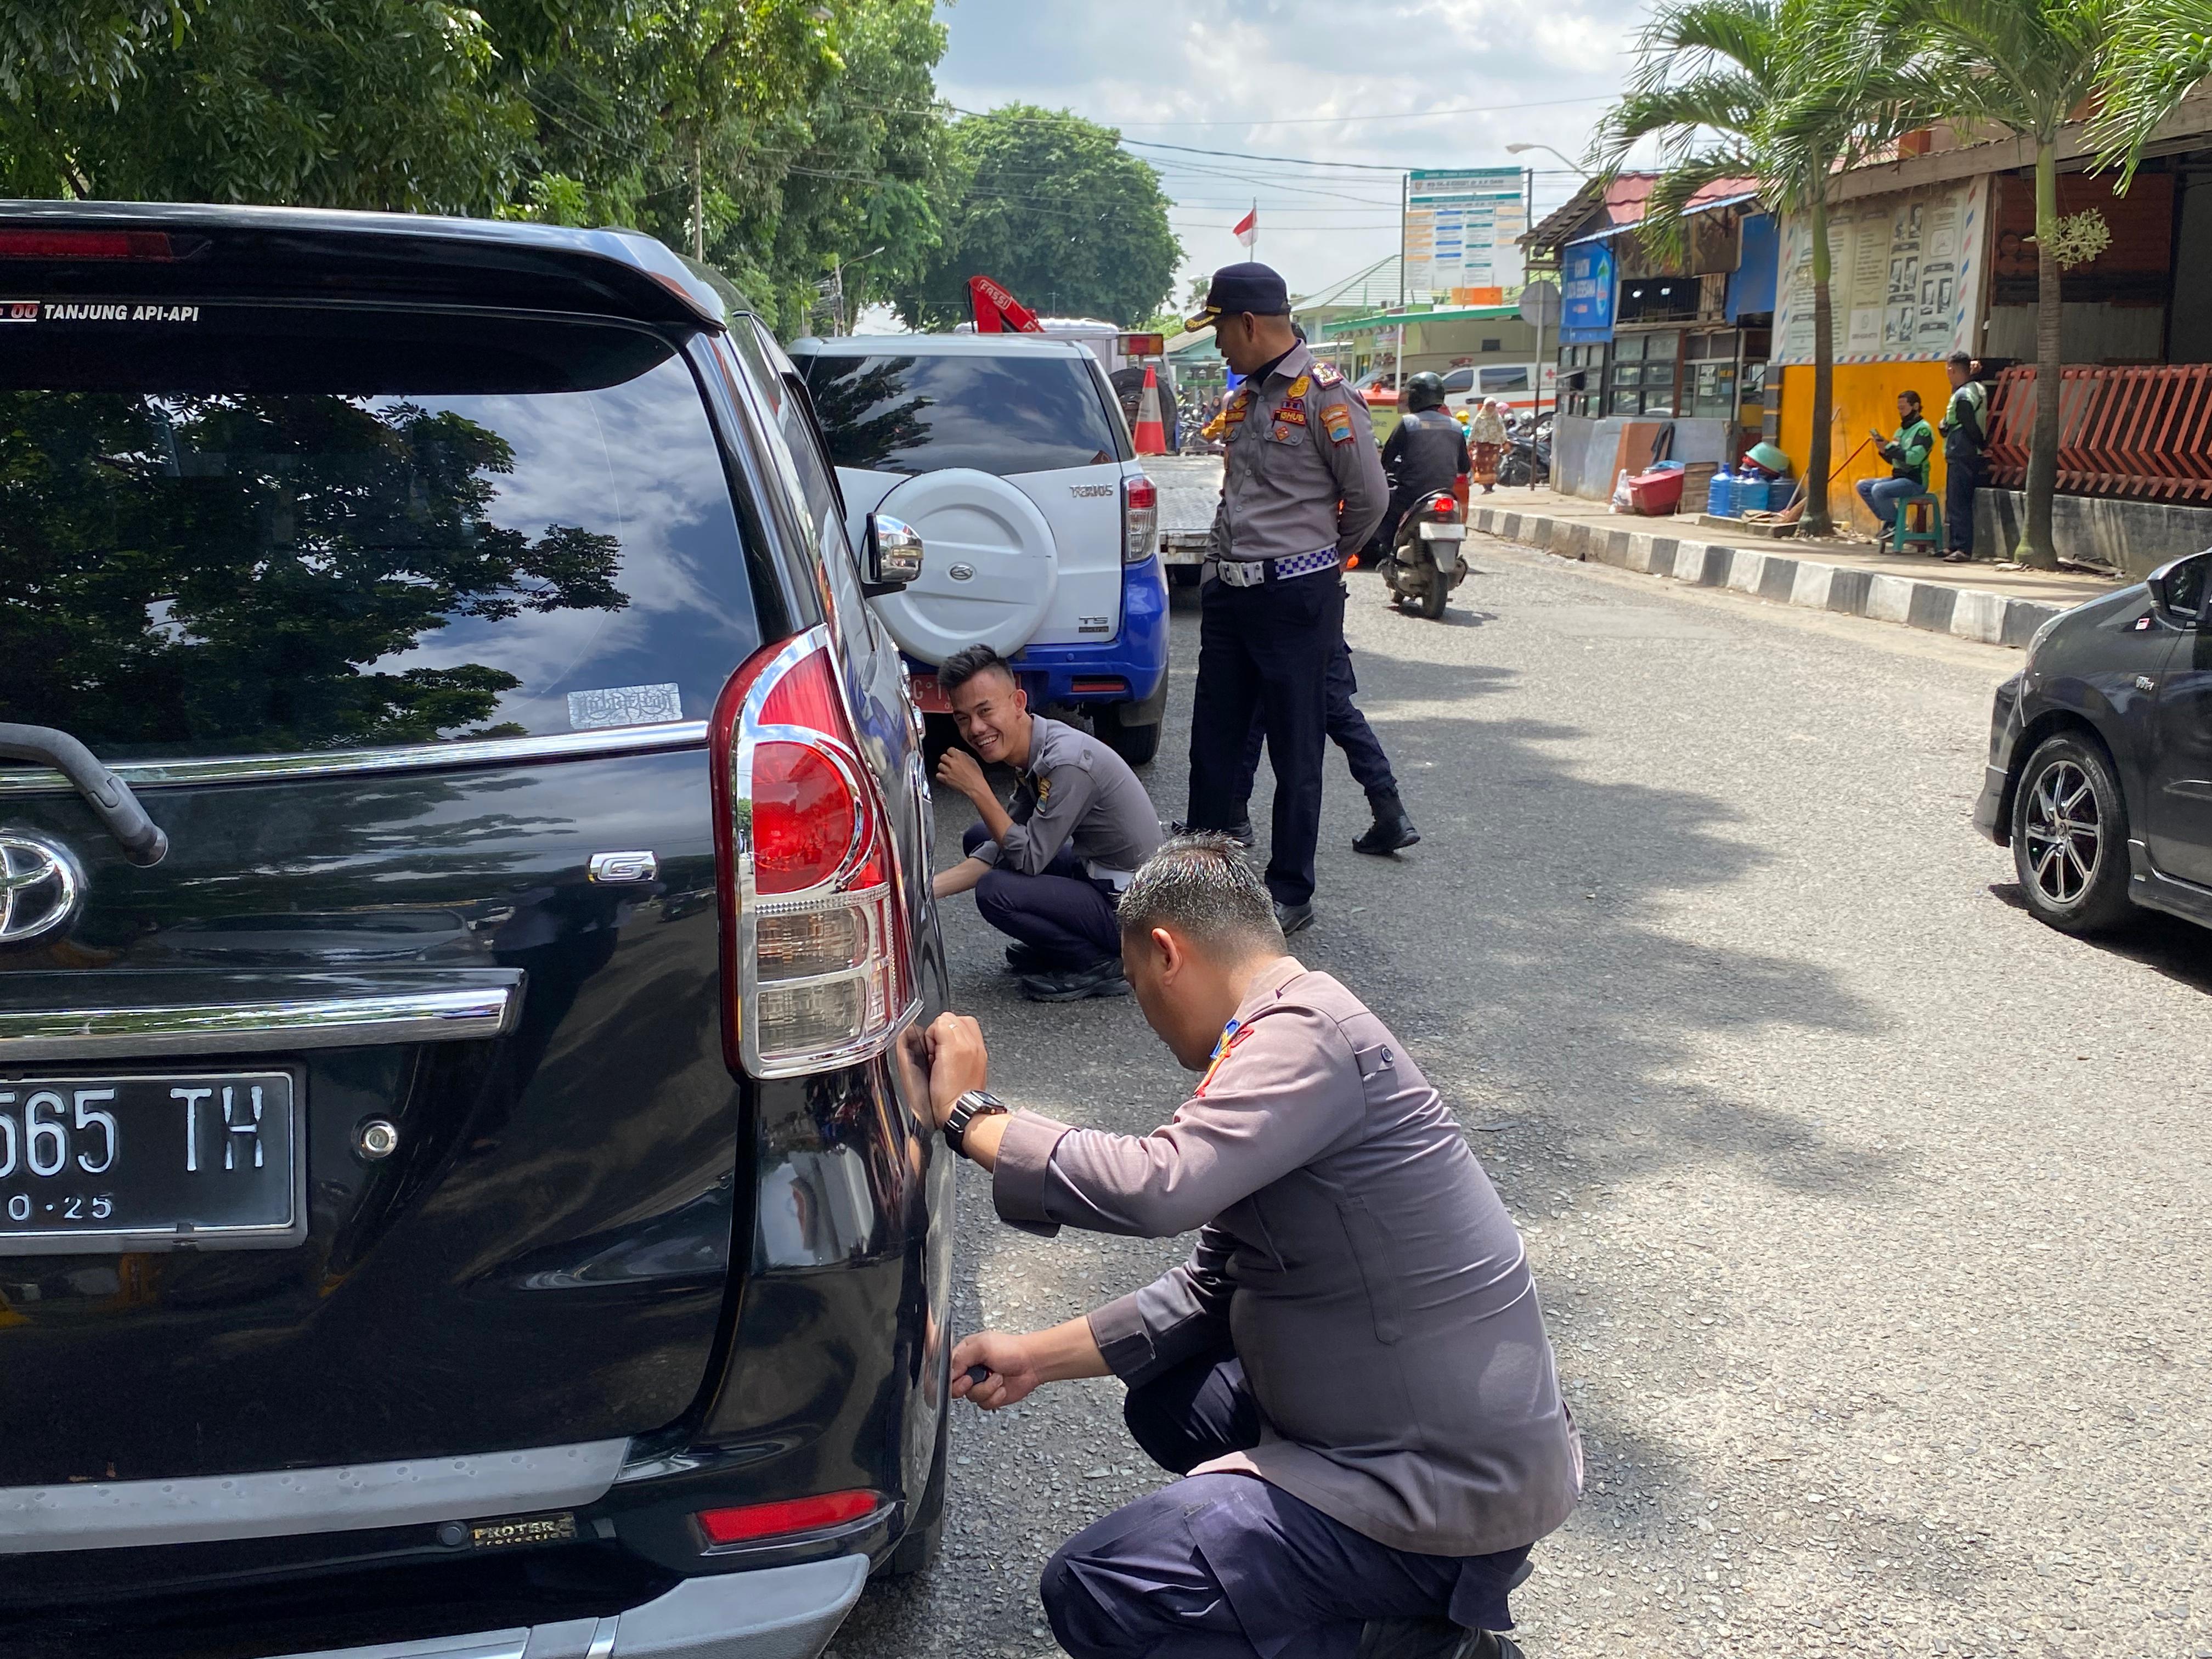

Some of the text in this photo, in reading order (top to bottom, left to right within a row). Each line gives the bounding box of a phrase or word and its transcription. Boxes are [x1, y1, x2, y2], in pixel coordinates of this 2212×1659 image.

[980, 282, 1008, 307] FASSI
[44, 304, 127, 320] TANJUNG
[132, 306, 199, 321] API-API
[1079, 616, 1108, 624] TS
[170, 1086, 263, 1172] TH
